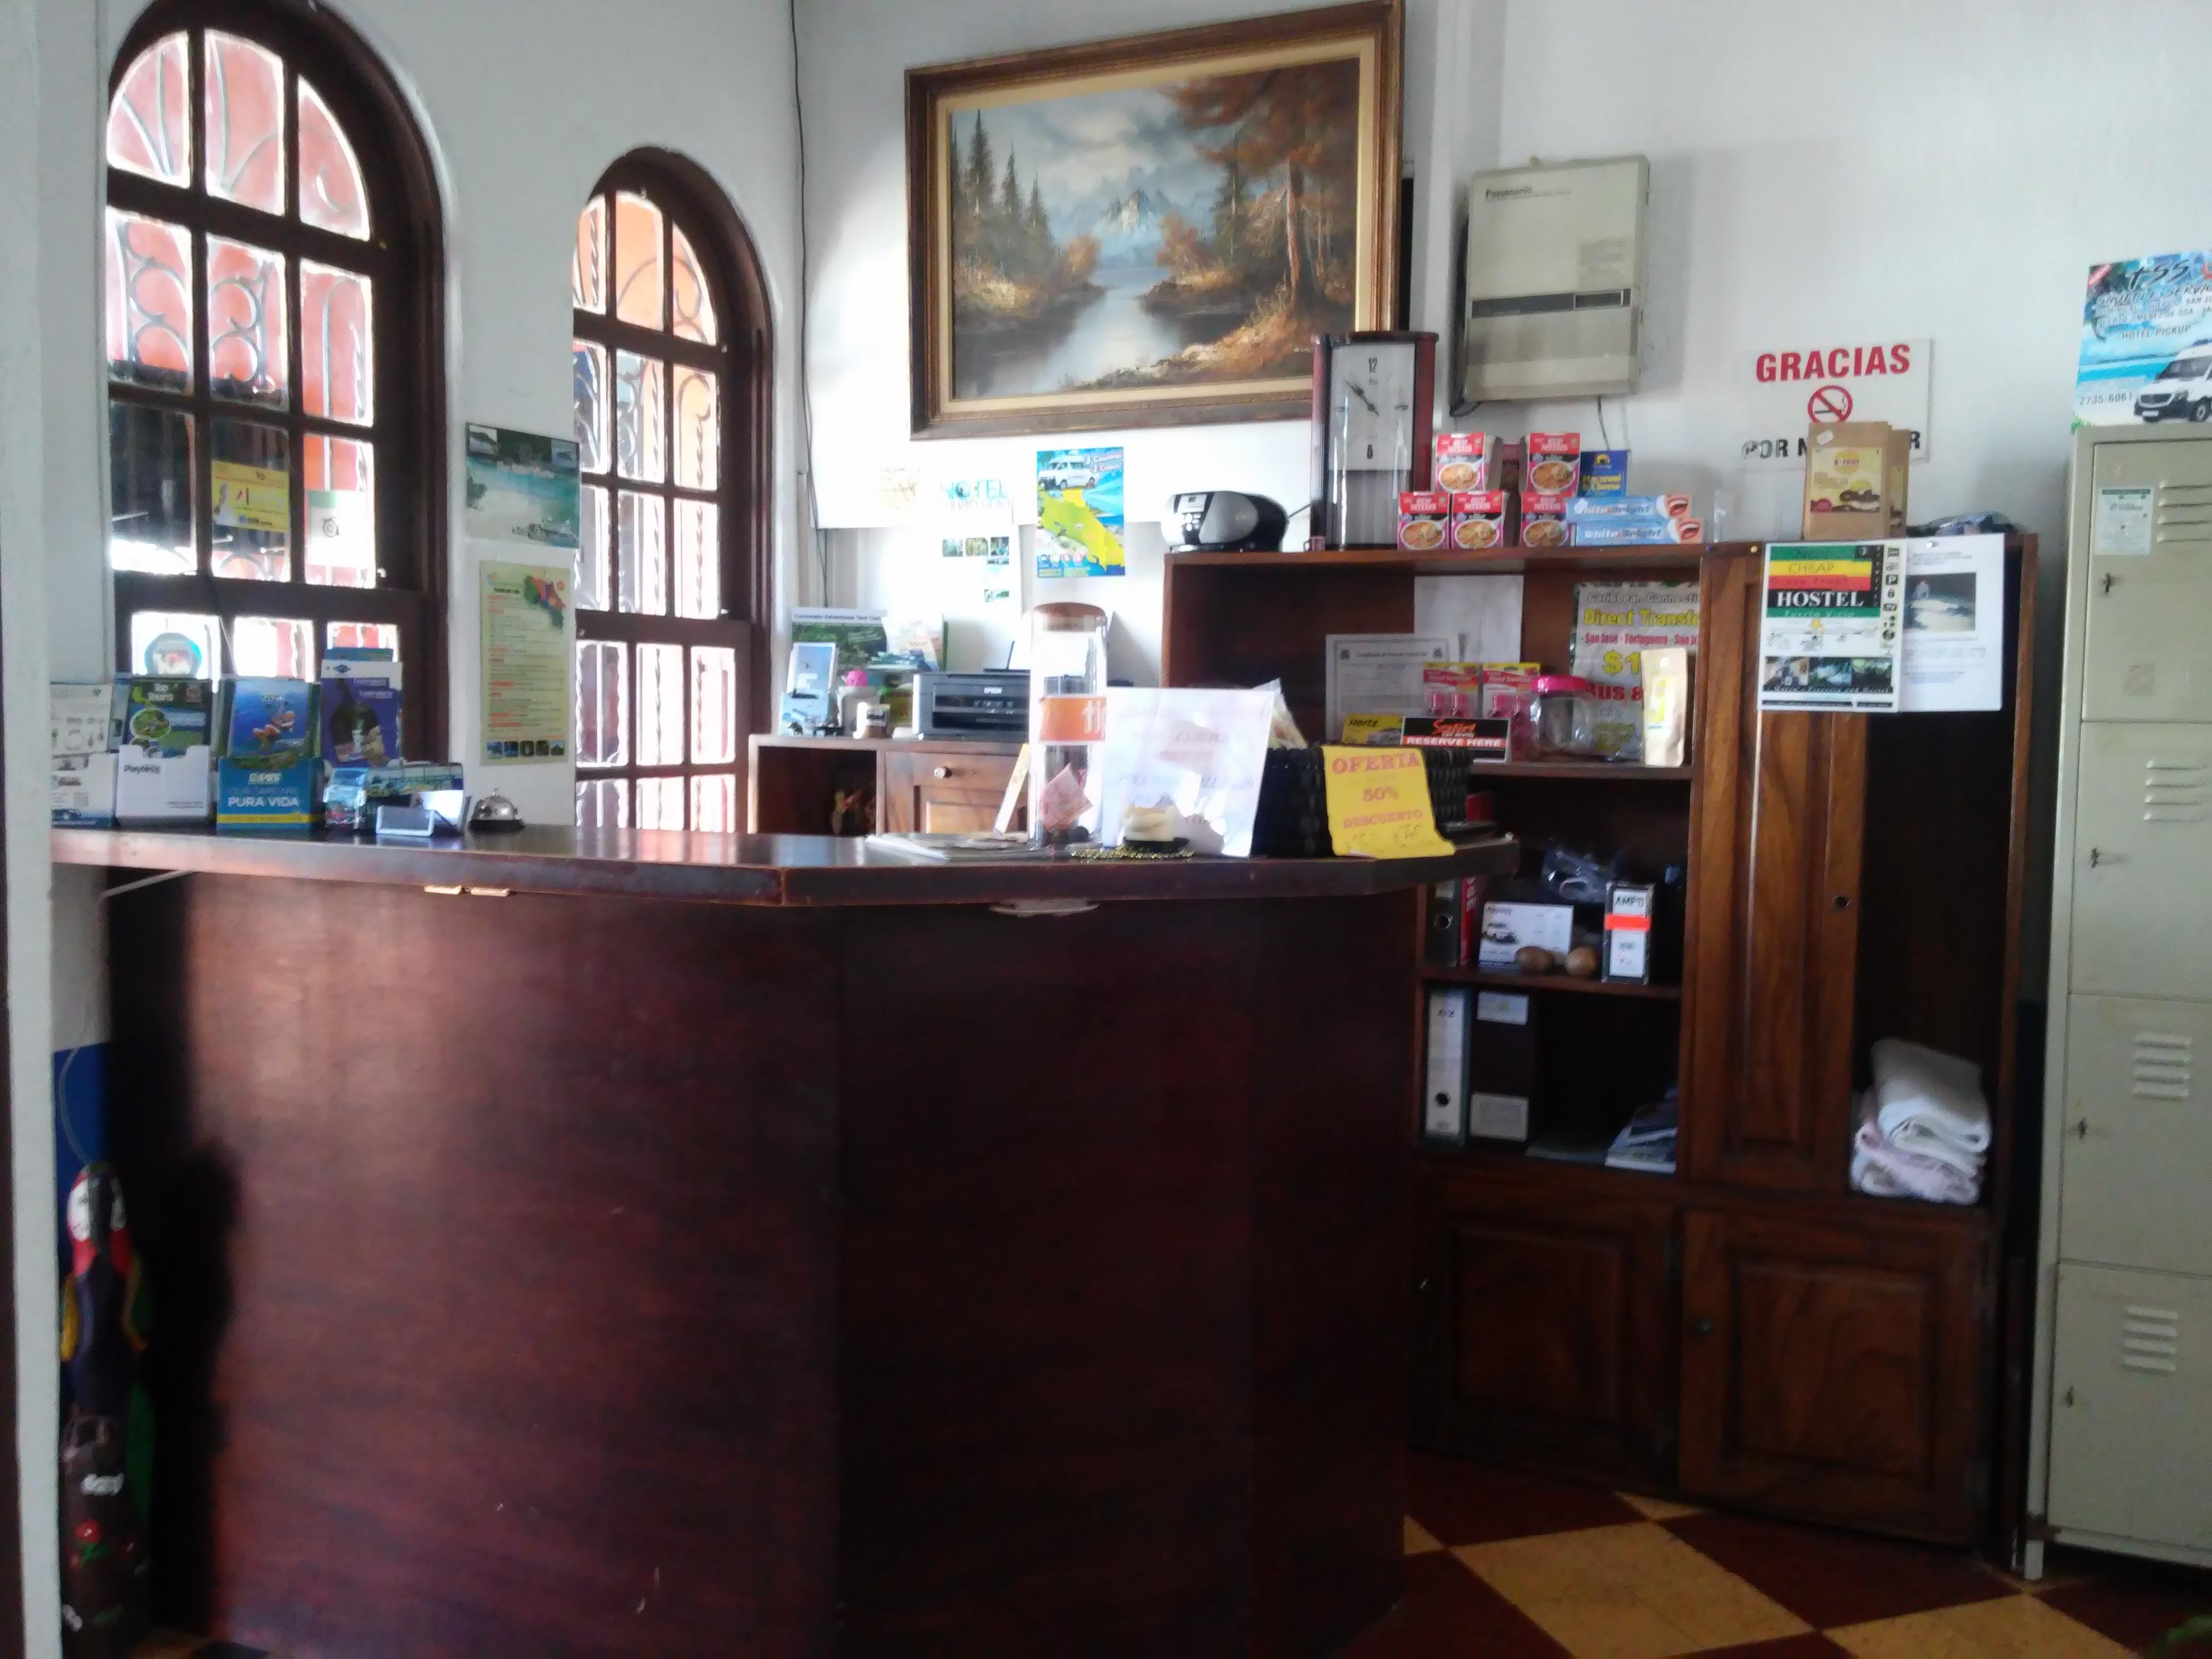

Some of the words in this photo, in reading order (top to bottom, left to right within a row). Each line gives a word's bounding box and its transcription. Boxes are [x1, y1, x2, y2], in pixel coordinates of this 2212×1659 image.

[1485, 186, 1532, 201] Panasonic
[2122, 330, 2152, 340] HOTEL
[2155, 325, 2191, 337] PICKUP
[1756, 343, 1910, 383] GRACIAS
[1742, 438, 1789, 459] POR
[1788, 563, 1834, 573] CHEAP
[1777, 590, 1864, 607] HOSTEL
[1583, 608, 1634, 626] Direct
[1406, 737, 1463, 746] RESERVE
[1467, 738, 1501, 747] HERE
[1331, 752, 1420, 774] OFERTA
[228, 797, 264, 807] PURA
[268, 797, 299, 807] VIDA
[1362, 786, 1398, 802] 50%
